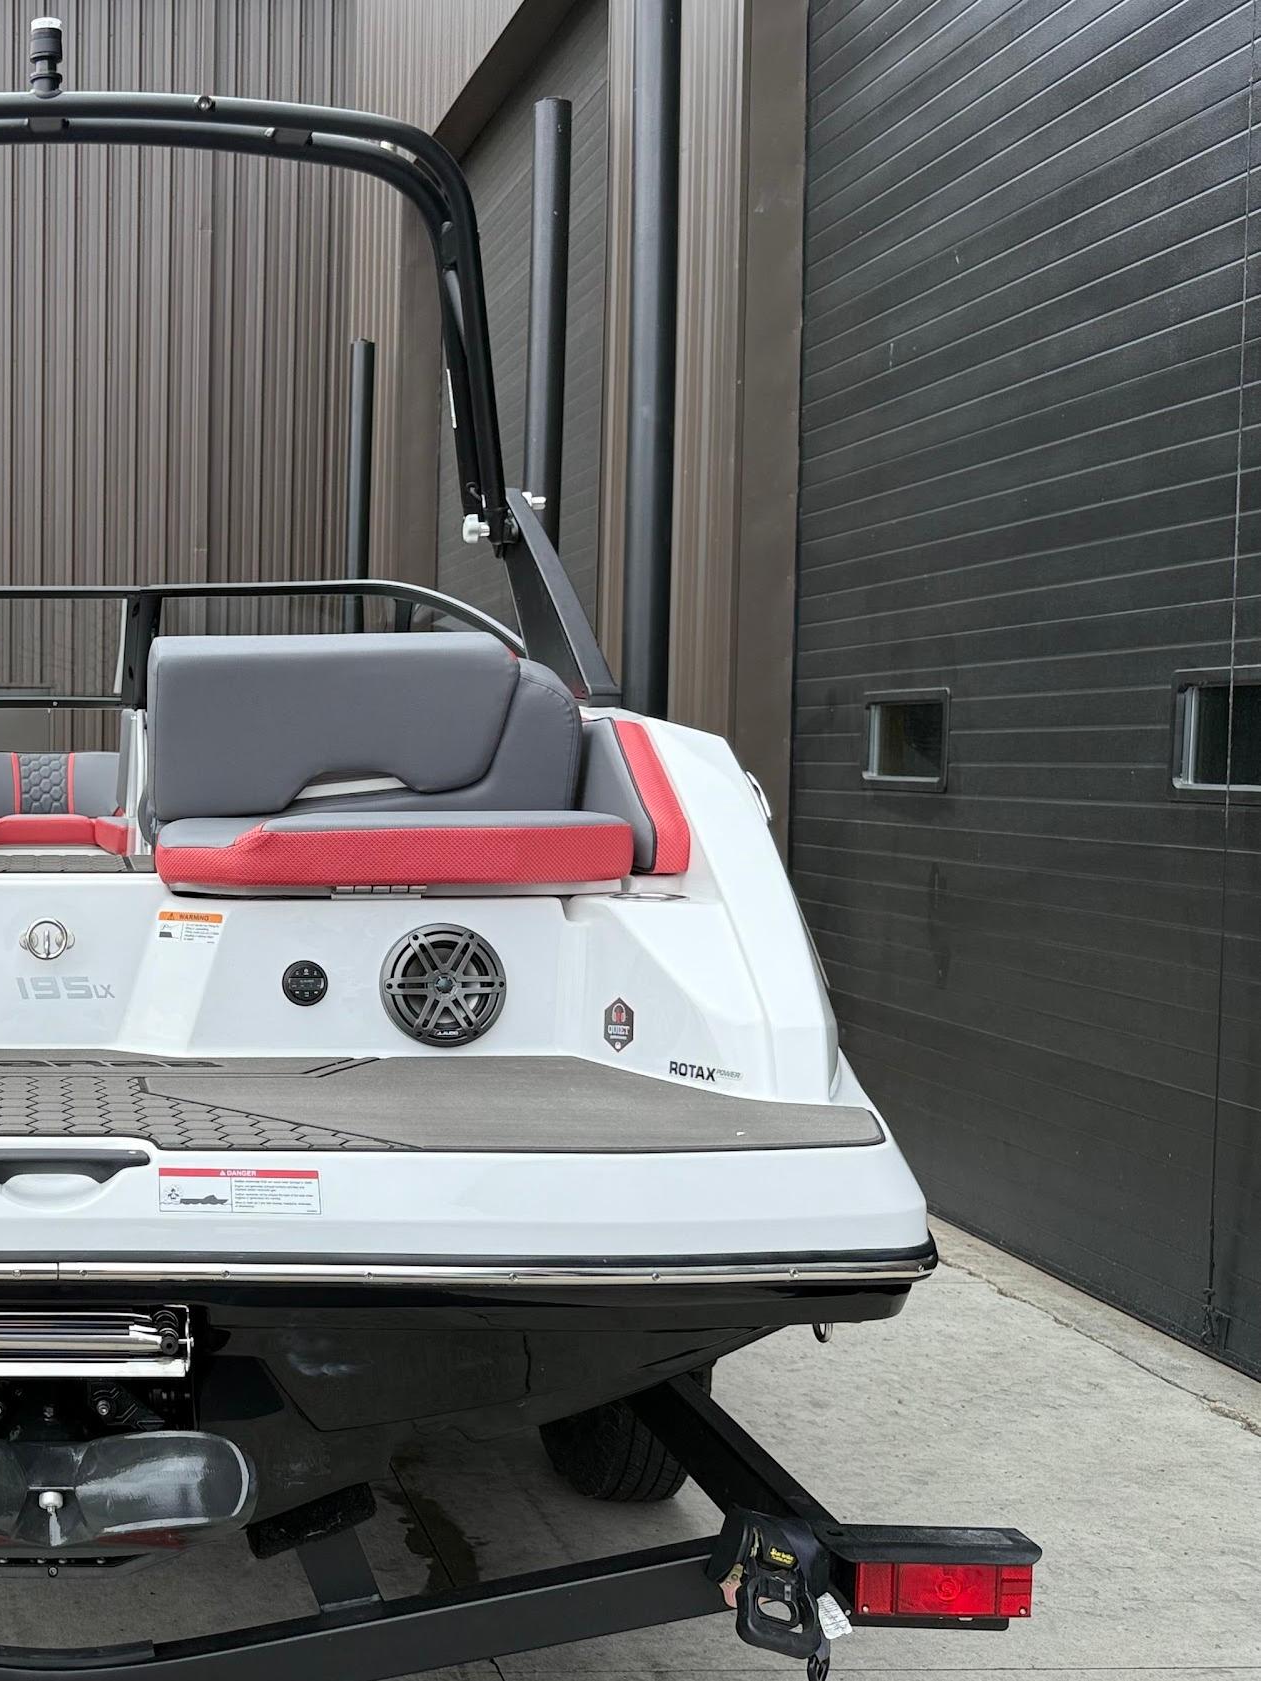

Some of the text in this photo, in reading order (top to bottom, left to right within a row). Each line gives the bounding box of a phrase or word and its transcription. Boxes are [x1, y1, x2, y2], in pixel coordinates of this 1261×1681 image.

[179, 913, 210, 921] WARNING
[607, 1024, 630, 1036] QUIET
[668, 1060, 716, 1082] ROTAX
